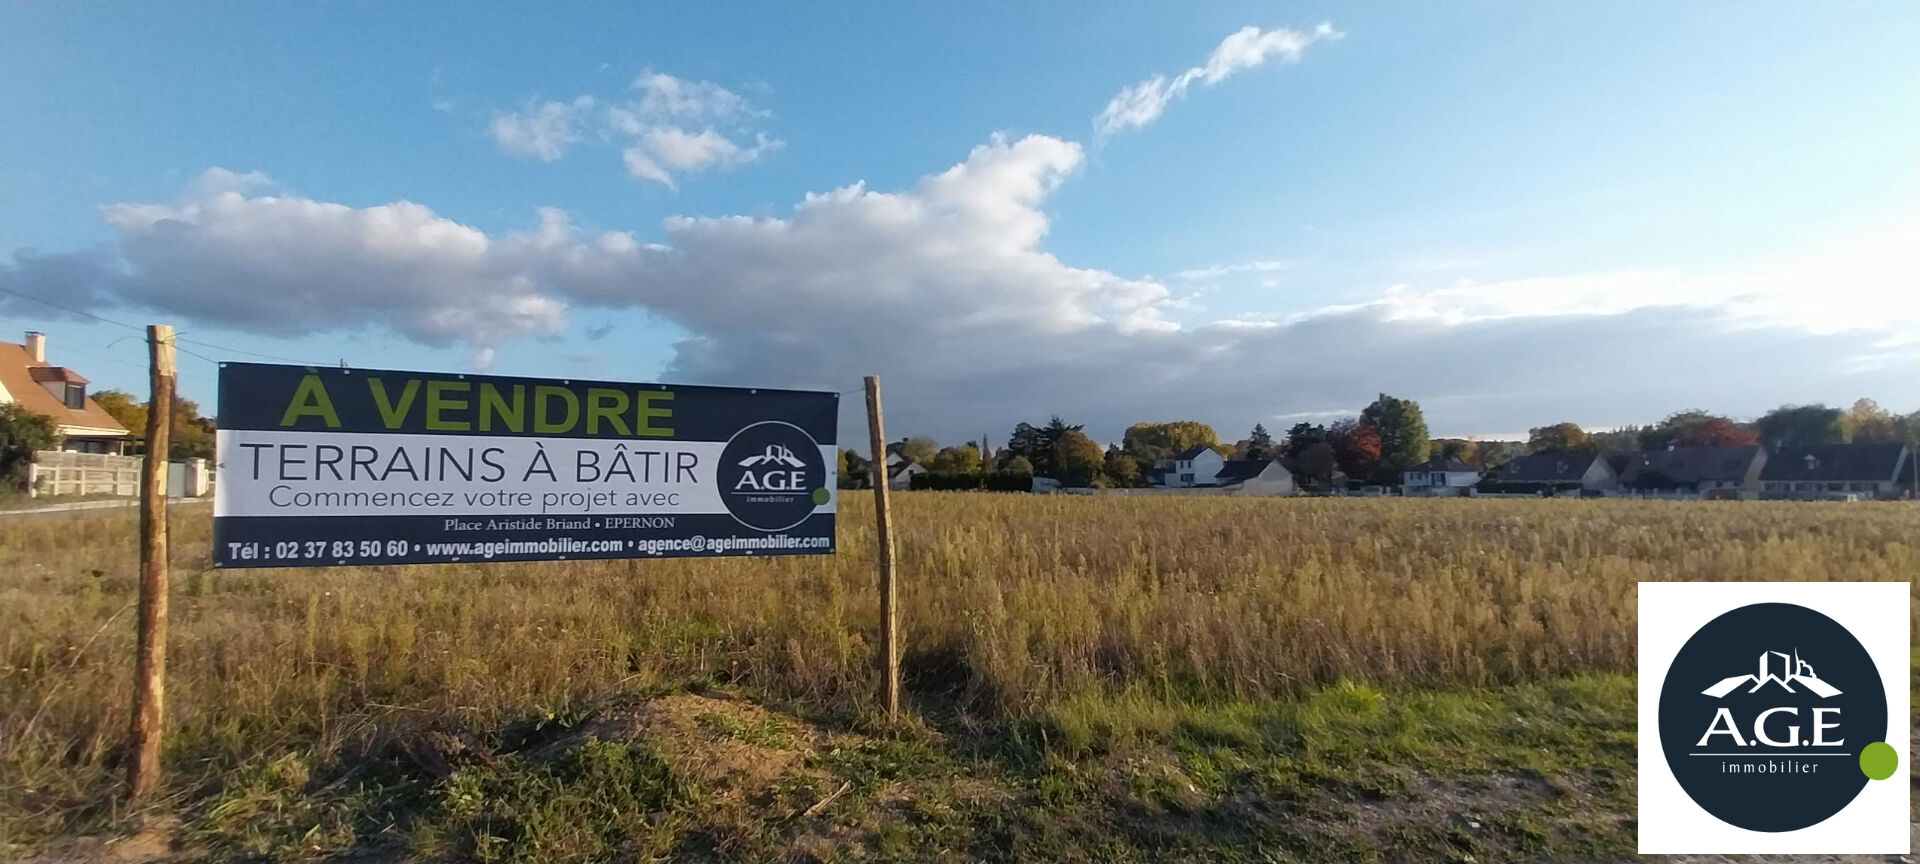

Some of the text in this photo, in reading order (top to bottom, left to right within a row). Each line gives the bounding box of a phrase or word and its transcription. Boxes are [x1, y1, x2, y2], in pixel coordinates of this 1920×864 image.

[279, 366, 676, 438] À VENDRE
[239, 441, 699, 484] TERRAINS À BÂTIR
[734, 470, 807, 491] A.G.E
[269, 485, 680, 513] Commencez votre projet avec
[444, 517, 675, 531] Place Aristide Briand EPERNON
[228, 542, 259, 560] Tél
[276, 541, 298, 559] 02
[303, 541, 326, 559] 37
[332, 541, 354, 558] 83
[359, 540, 382, 557] 50
[386, 540, 408, 557] 60
[426, 538, 623, 557] www.ageimmobilier.com
[638, 534, 830, 555] agence@ageimmobilier.com
